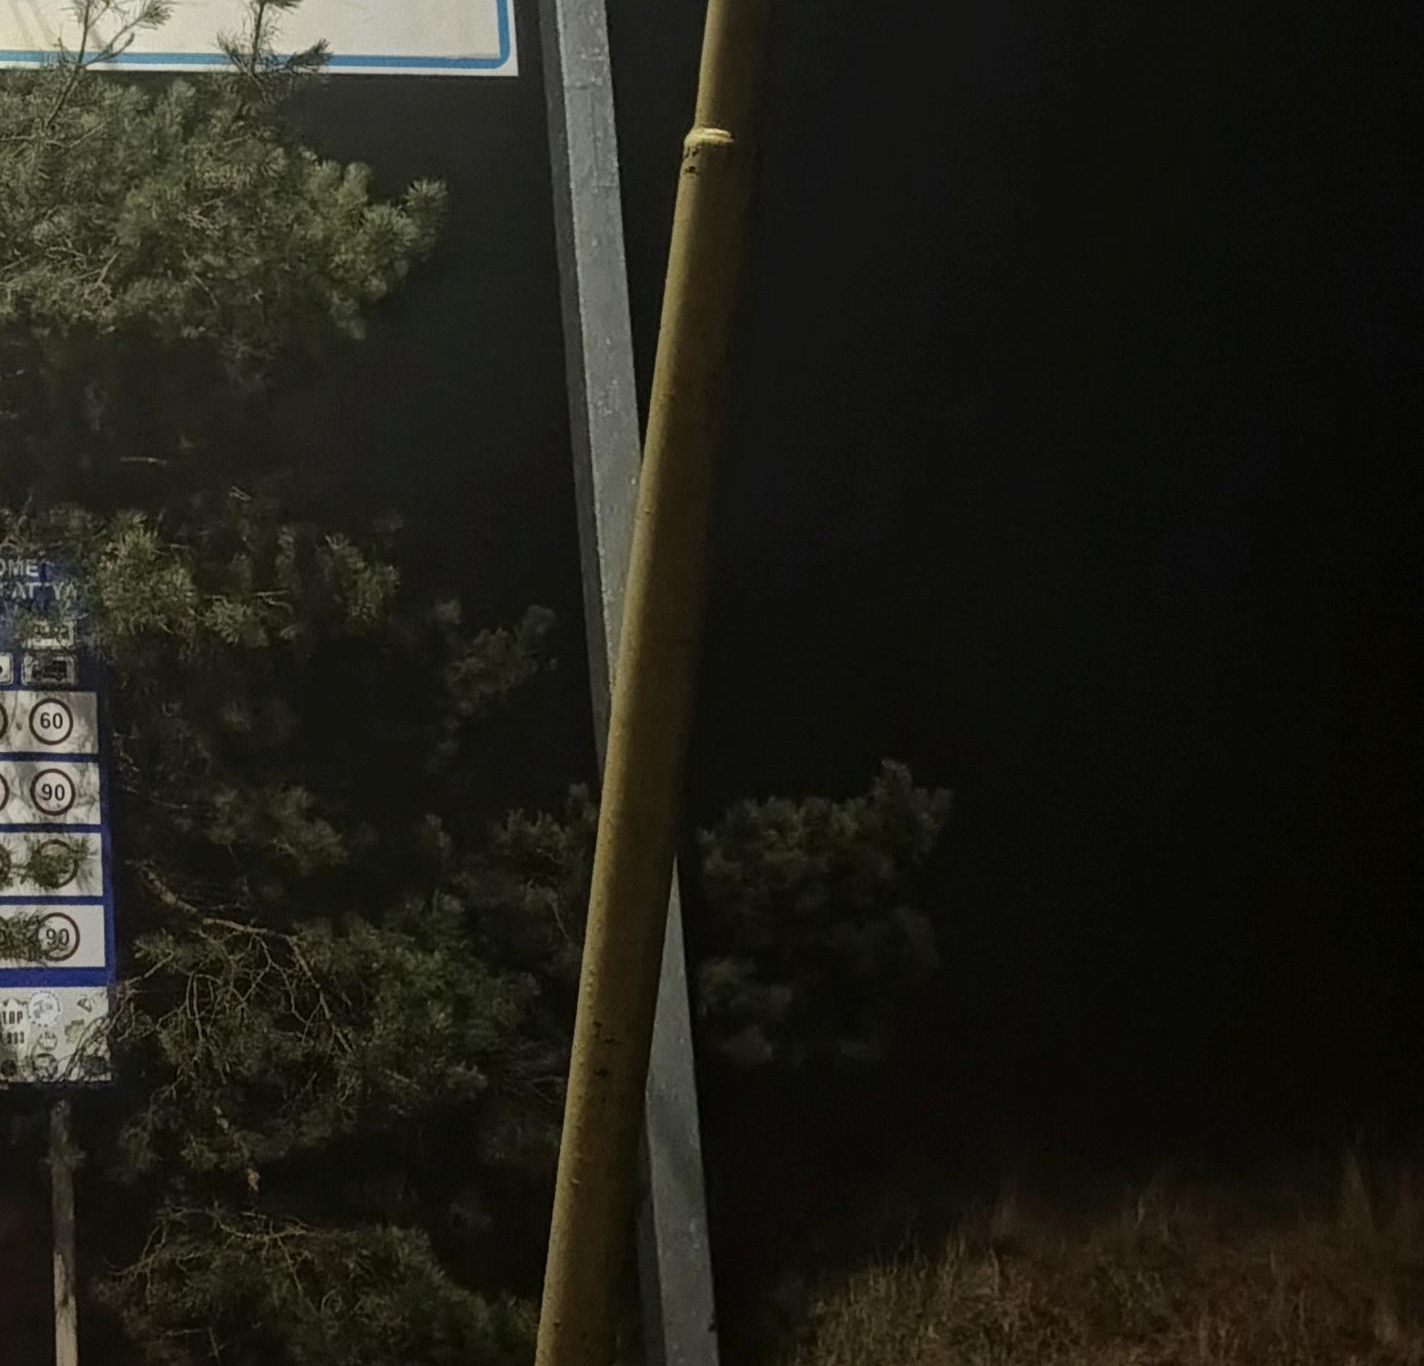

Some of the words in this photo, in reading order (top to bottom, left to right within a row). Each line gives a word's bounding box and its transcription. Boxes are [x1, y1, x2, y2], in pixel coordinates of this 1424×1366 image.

[39, 711, 64, 731] 60
[41, 783, 66, 802] 90
[45, 927, 70, 948] 90
